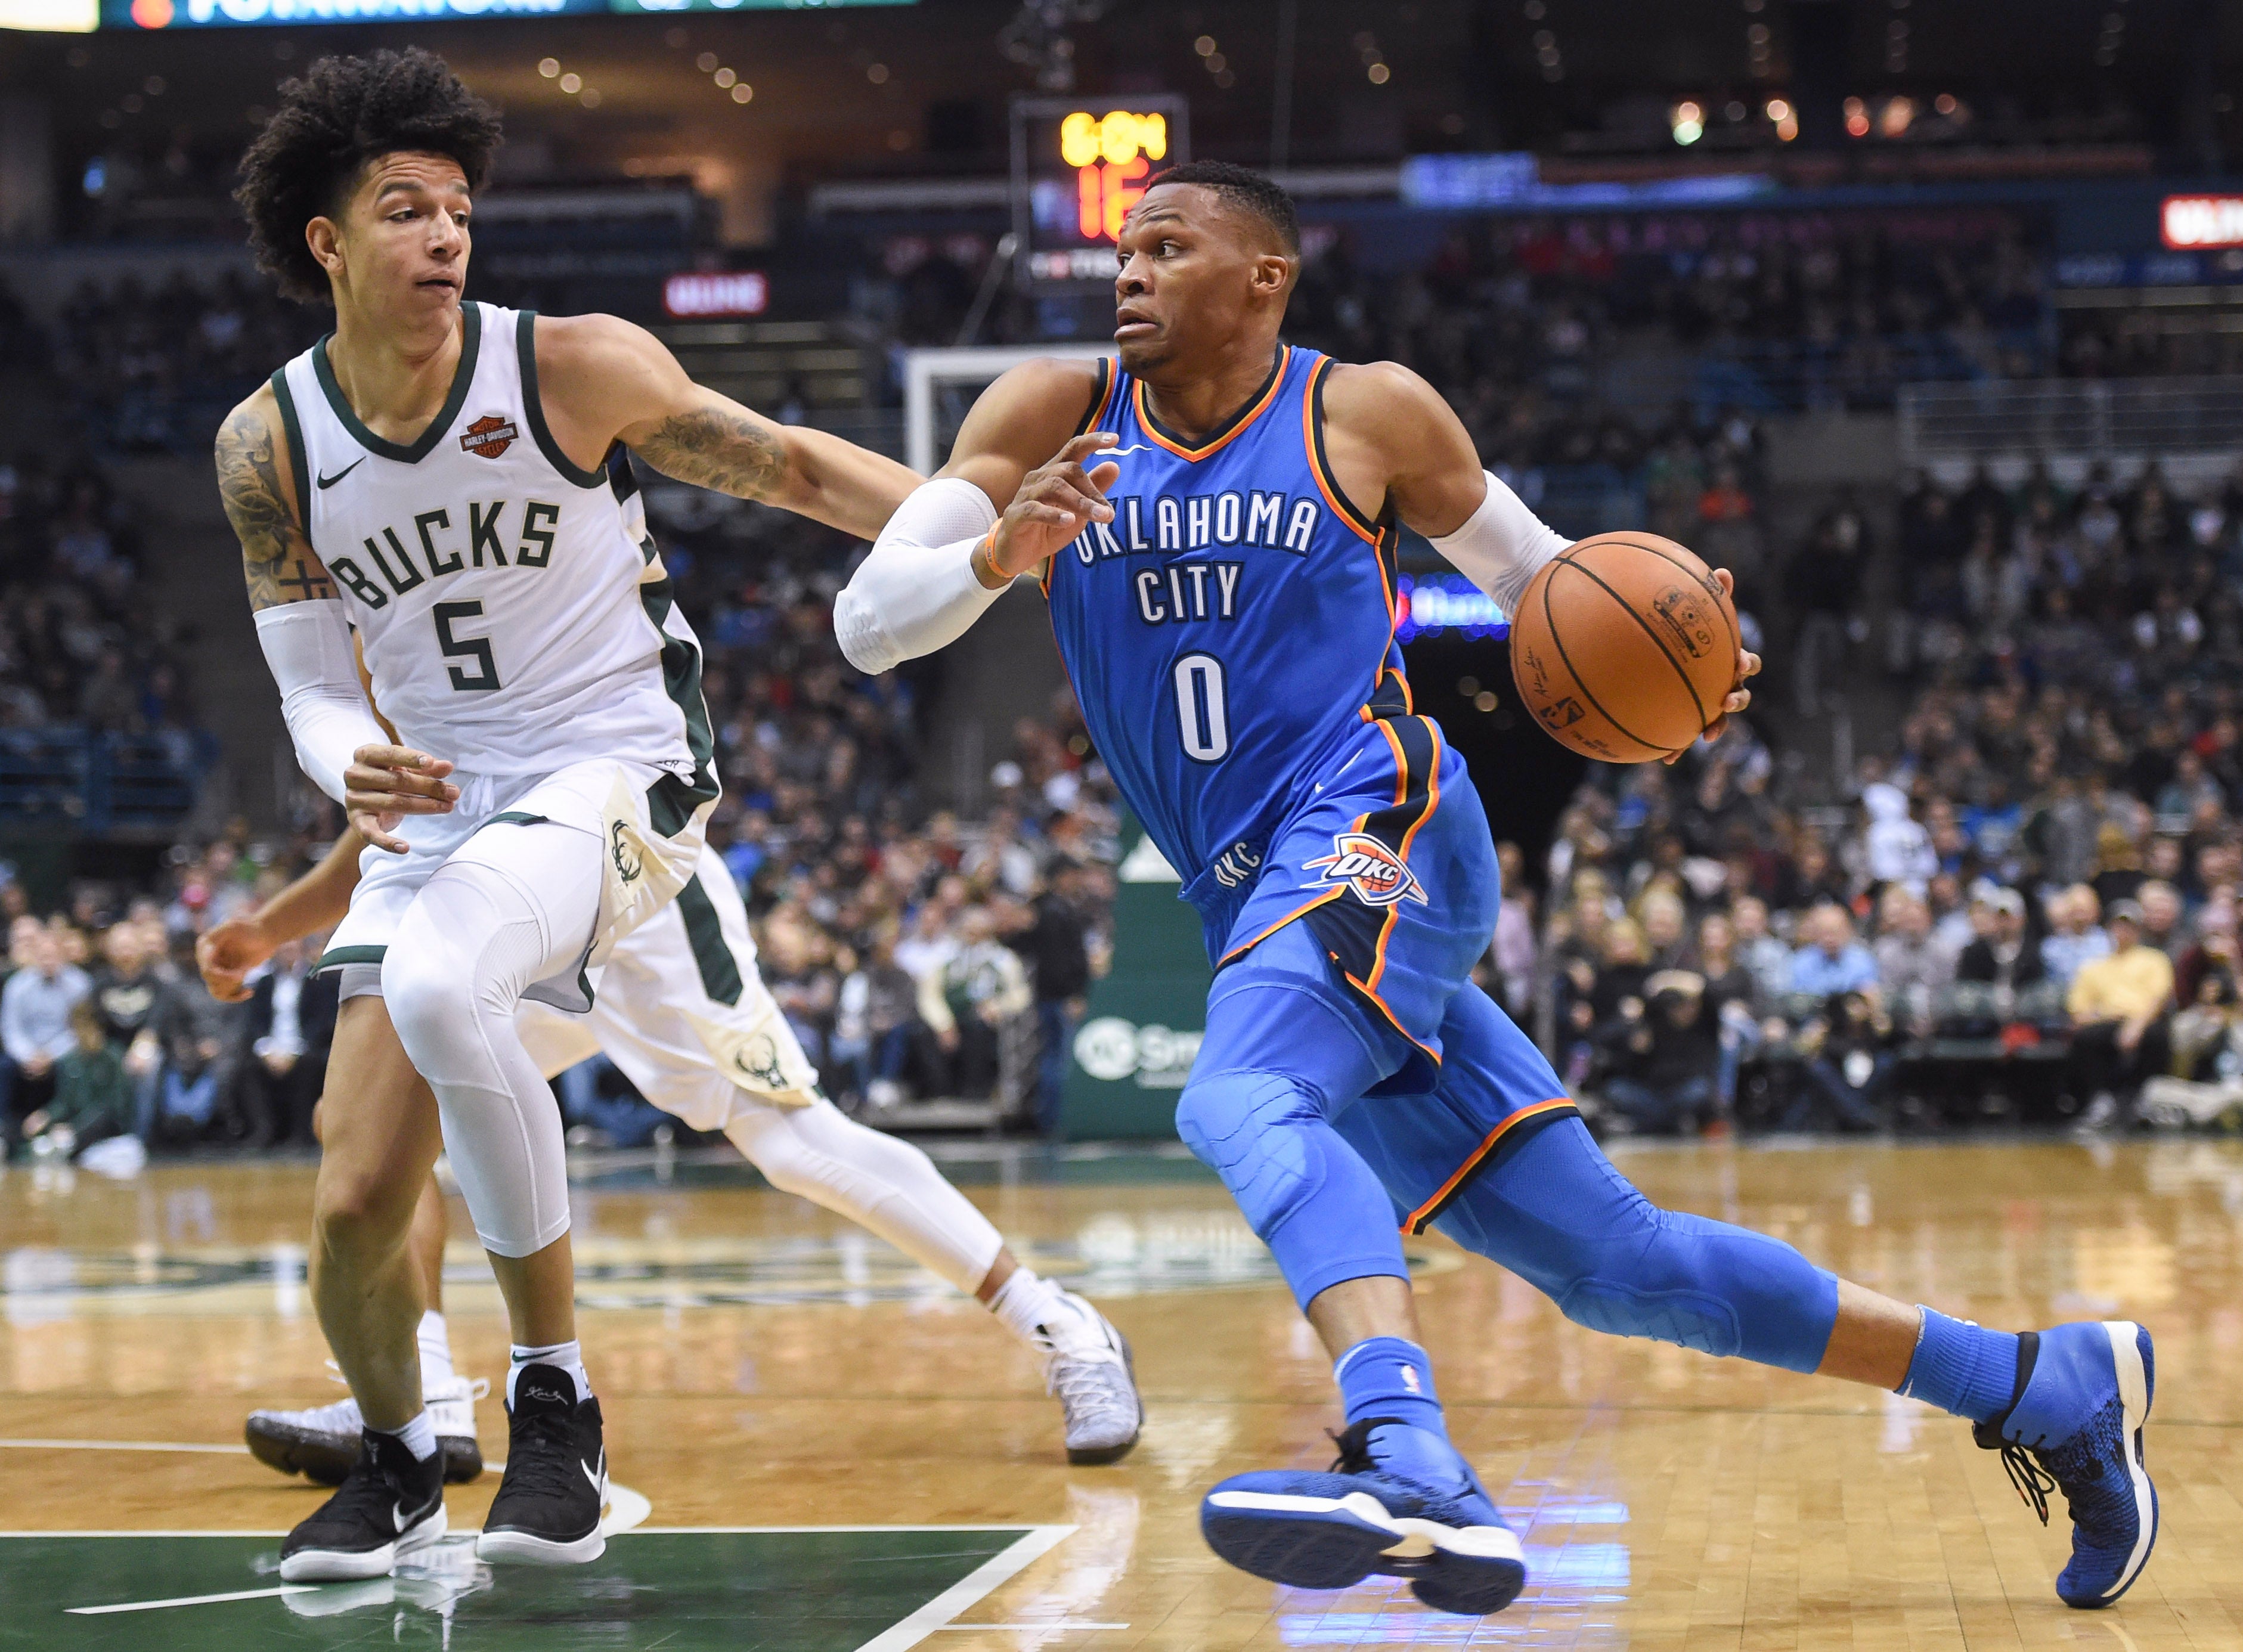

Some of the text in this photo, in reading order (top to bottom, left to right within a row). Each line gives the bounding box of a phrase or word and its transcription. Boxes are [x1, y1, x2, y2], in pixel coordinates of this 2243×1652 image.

[329, 498, 561, 610] BUCKS
[1136, 563, 1241, 624] CITY
[432, 599, 501, 692] 5
[1172, 652, 1231, 764] 0
[1214, 842, 1260, 888] OKC
[1328, 852, 1399, 881] OKC
